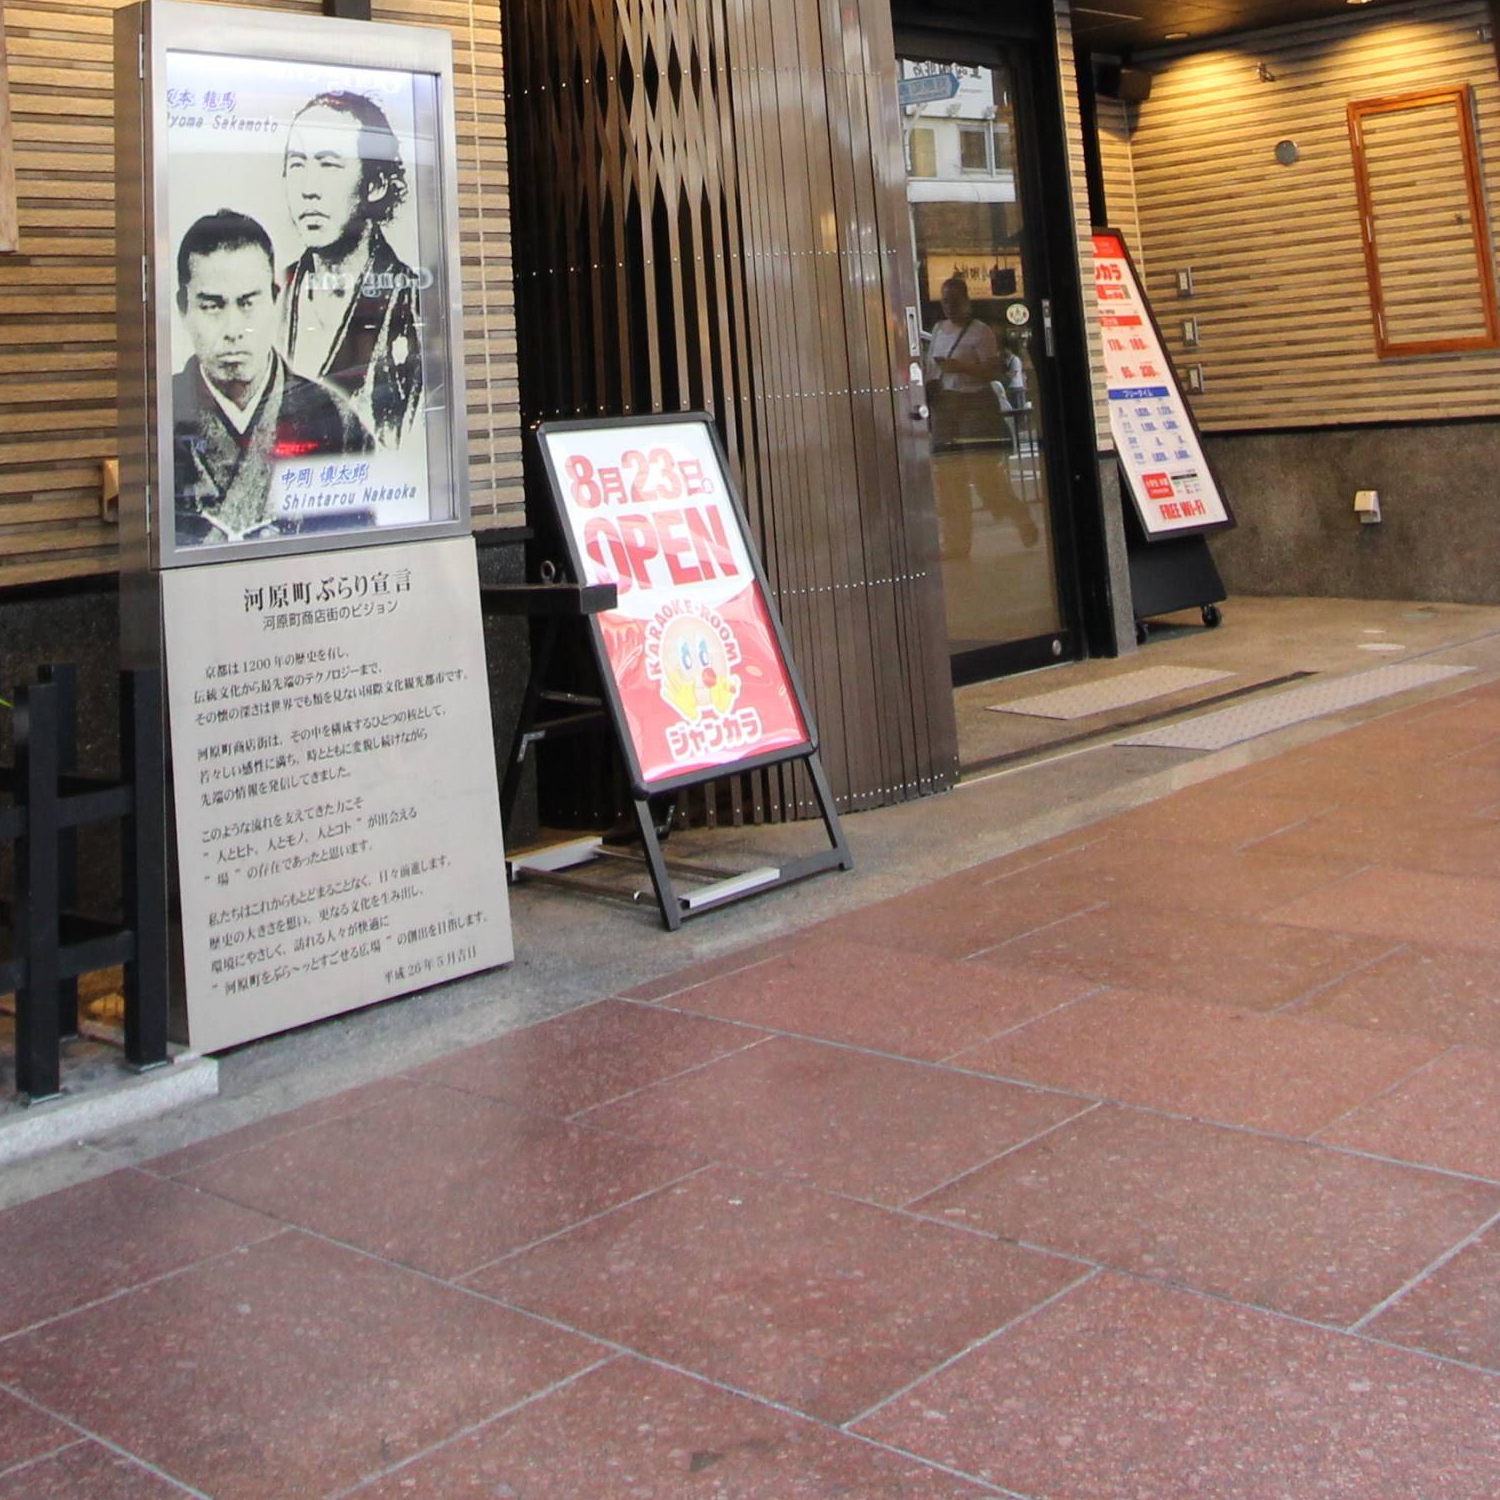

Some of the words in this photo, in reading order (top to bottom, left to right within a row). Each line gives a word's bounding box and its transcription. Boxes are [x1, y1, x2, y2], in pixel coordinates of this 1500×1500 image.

[211, 114, 279, 134] Sakamoto
[281, 466, 314, 491] 中岡
[319, 462, 370, 488] 慎太郎
[282, 490, 357, 512] Shintarou
[362, 483, 418, 503] Nakaoka
[584, 504, 740, 595] OPEN
[244, 567, 412, 613] 河原町ぶらり宣言
[262, 600, 399, 632] 河原町商店街のビジョン
[669, 709, 759, 757] ジャンカラ
